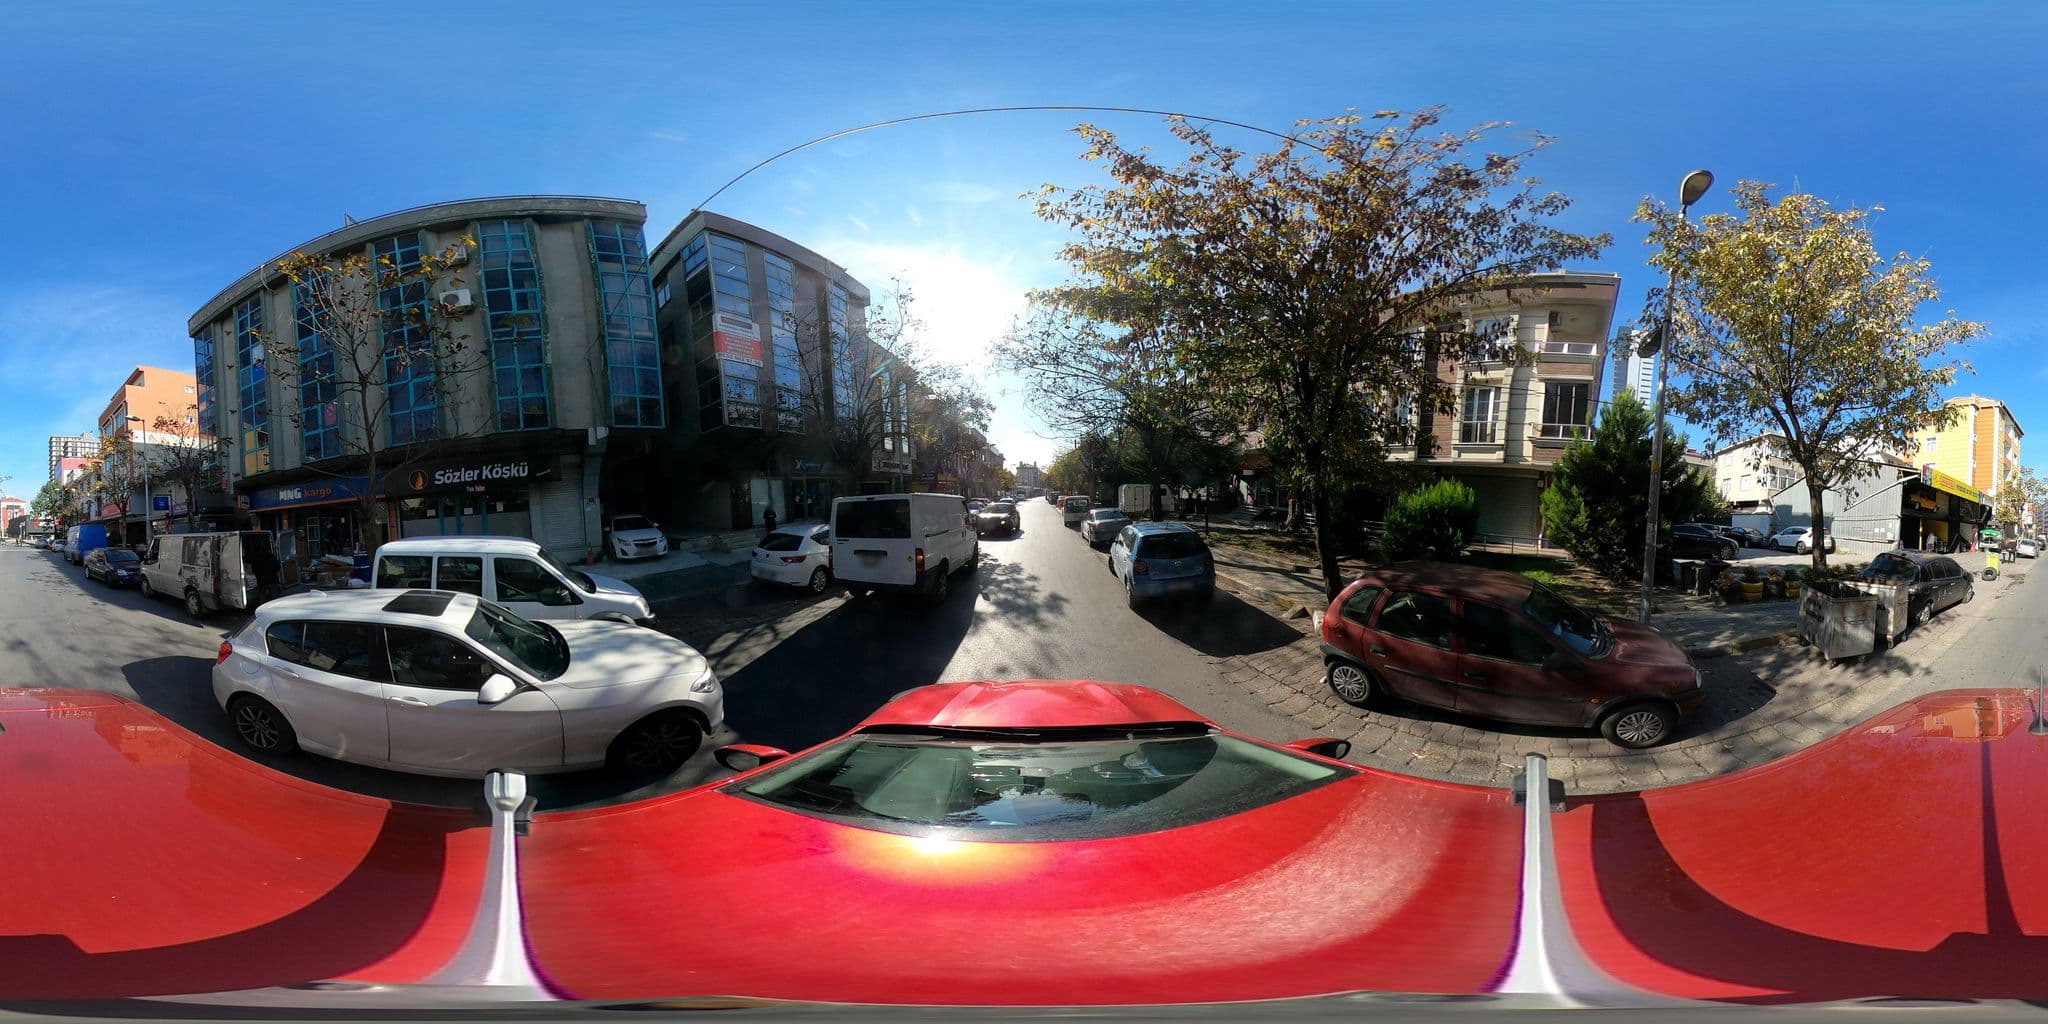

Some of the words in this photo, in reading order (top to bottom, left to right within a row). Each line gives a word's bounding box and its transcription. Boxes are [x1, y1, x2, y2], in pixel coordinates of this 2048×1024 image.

[434, 467, 481, 485] Sözler
[482, 462, 529, 479] Köşkü
[279, 488, 302, 501] MNG
[304, 487, 331, 498] kargo
